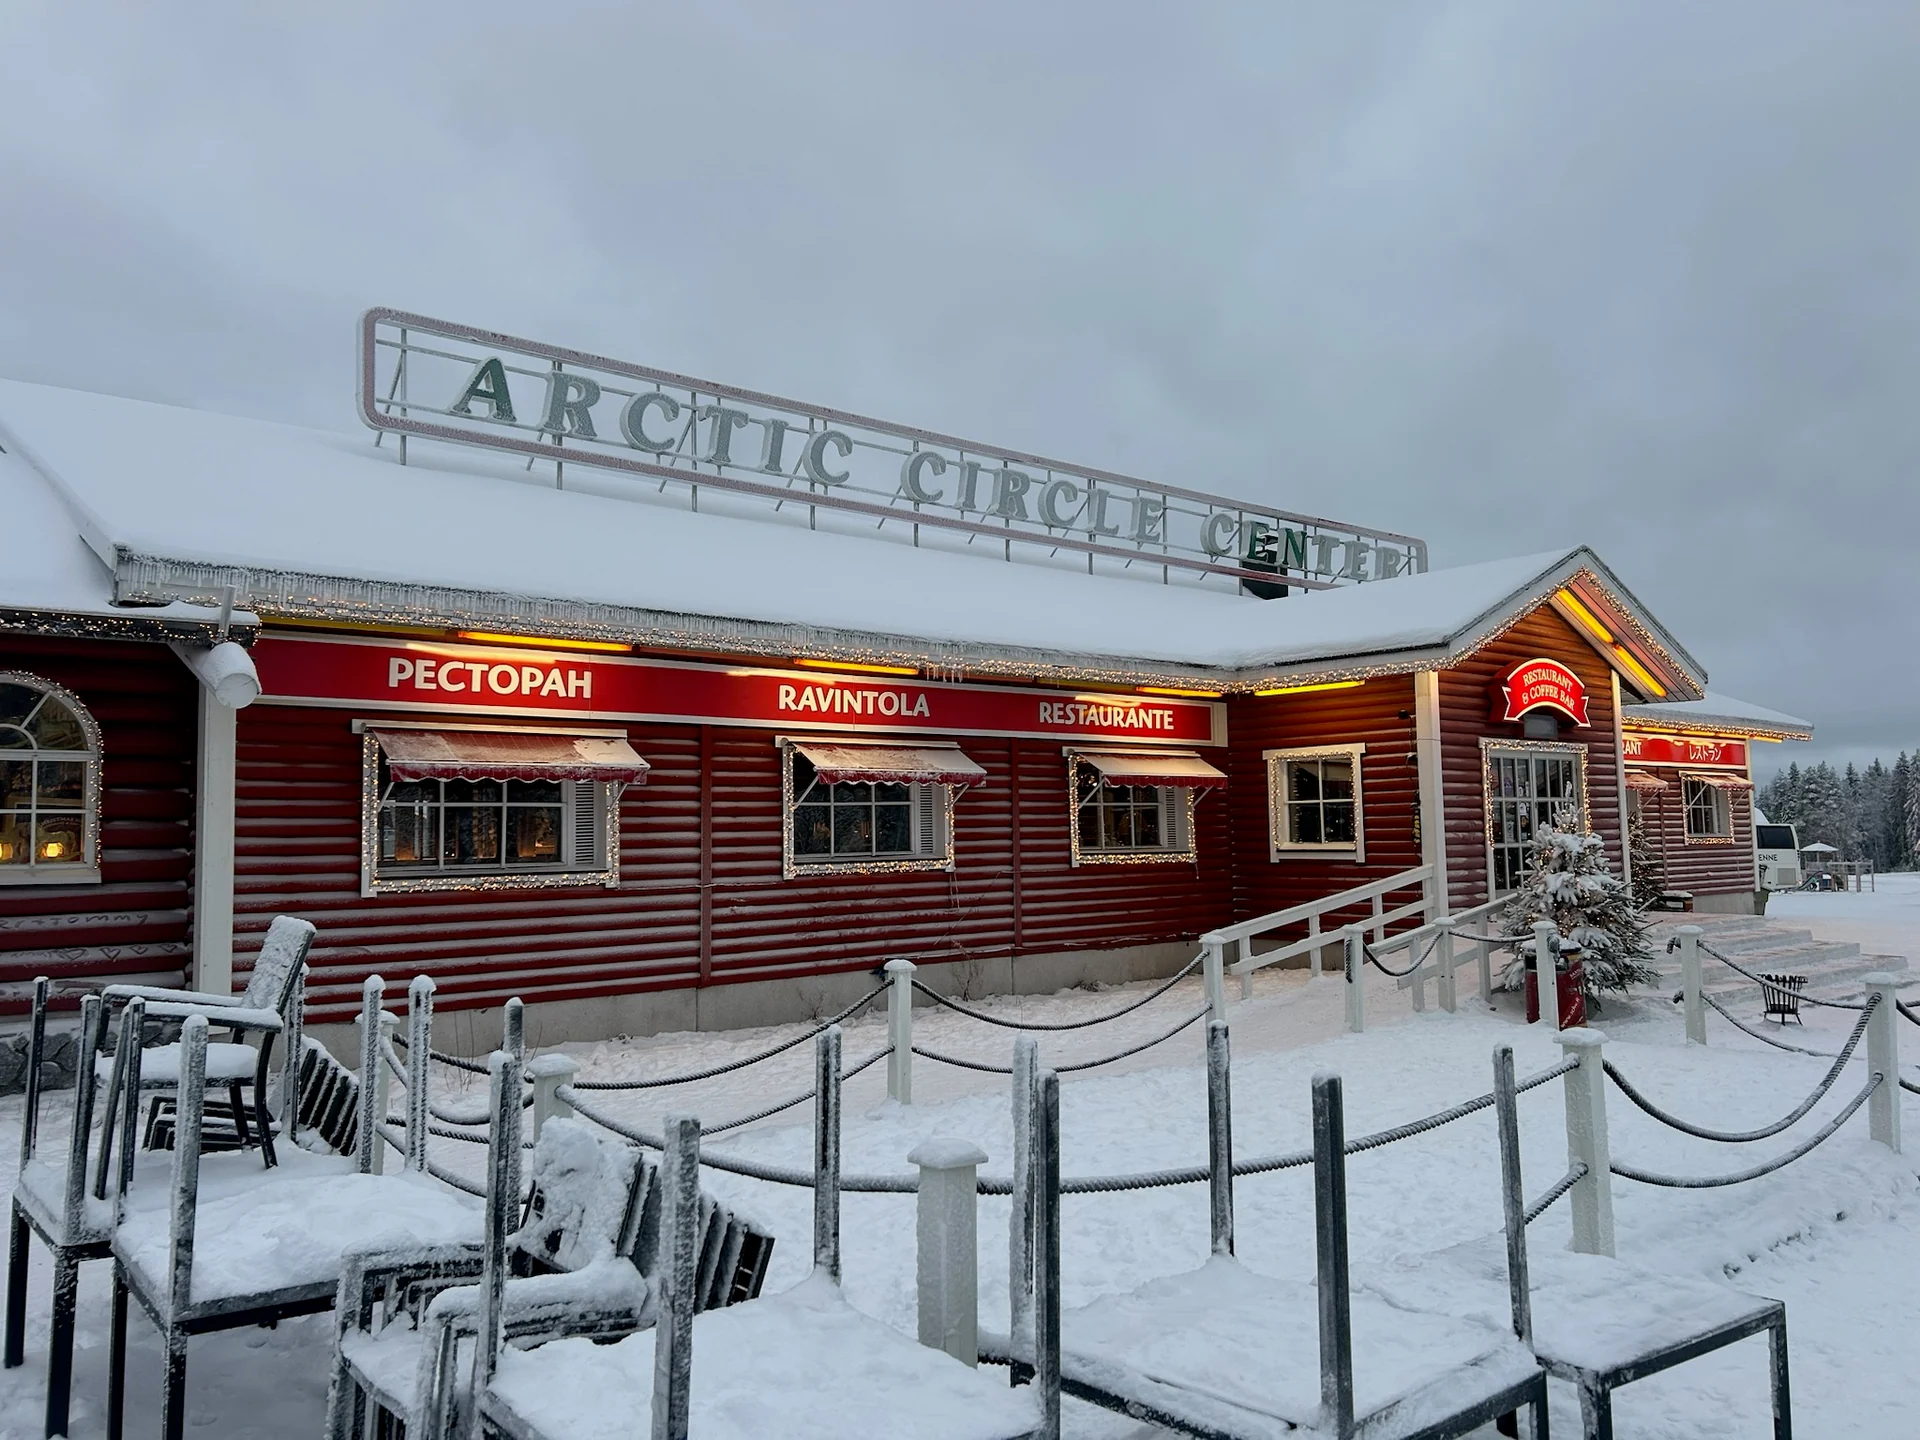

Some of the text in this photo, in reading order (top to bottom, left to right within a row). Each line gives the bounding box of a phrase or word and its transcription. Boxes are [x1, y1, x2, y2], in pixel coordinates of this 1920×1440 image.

[447, 355, 1401, 582] ARCTIC CIRCLE CENTER
[388, 657, 592, 699] РЕСТОРАН
[1522, 668, 1574, 692] RESTAURANT
[778, 684, 930, 718] RAVINTOLA
[1521, 684, 1575, 711] & COFFEE BAR
[1039, 701, 1174, 730] RESTAURANTE
[1689, 744, 1722, 761] レストラン
[1758, 853, 1778, 862] ENNE
